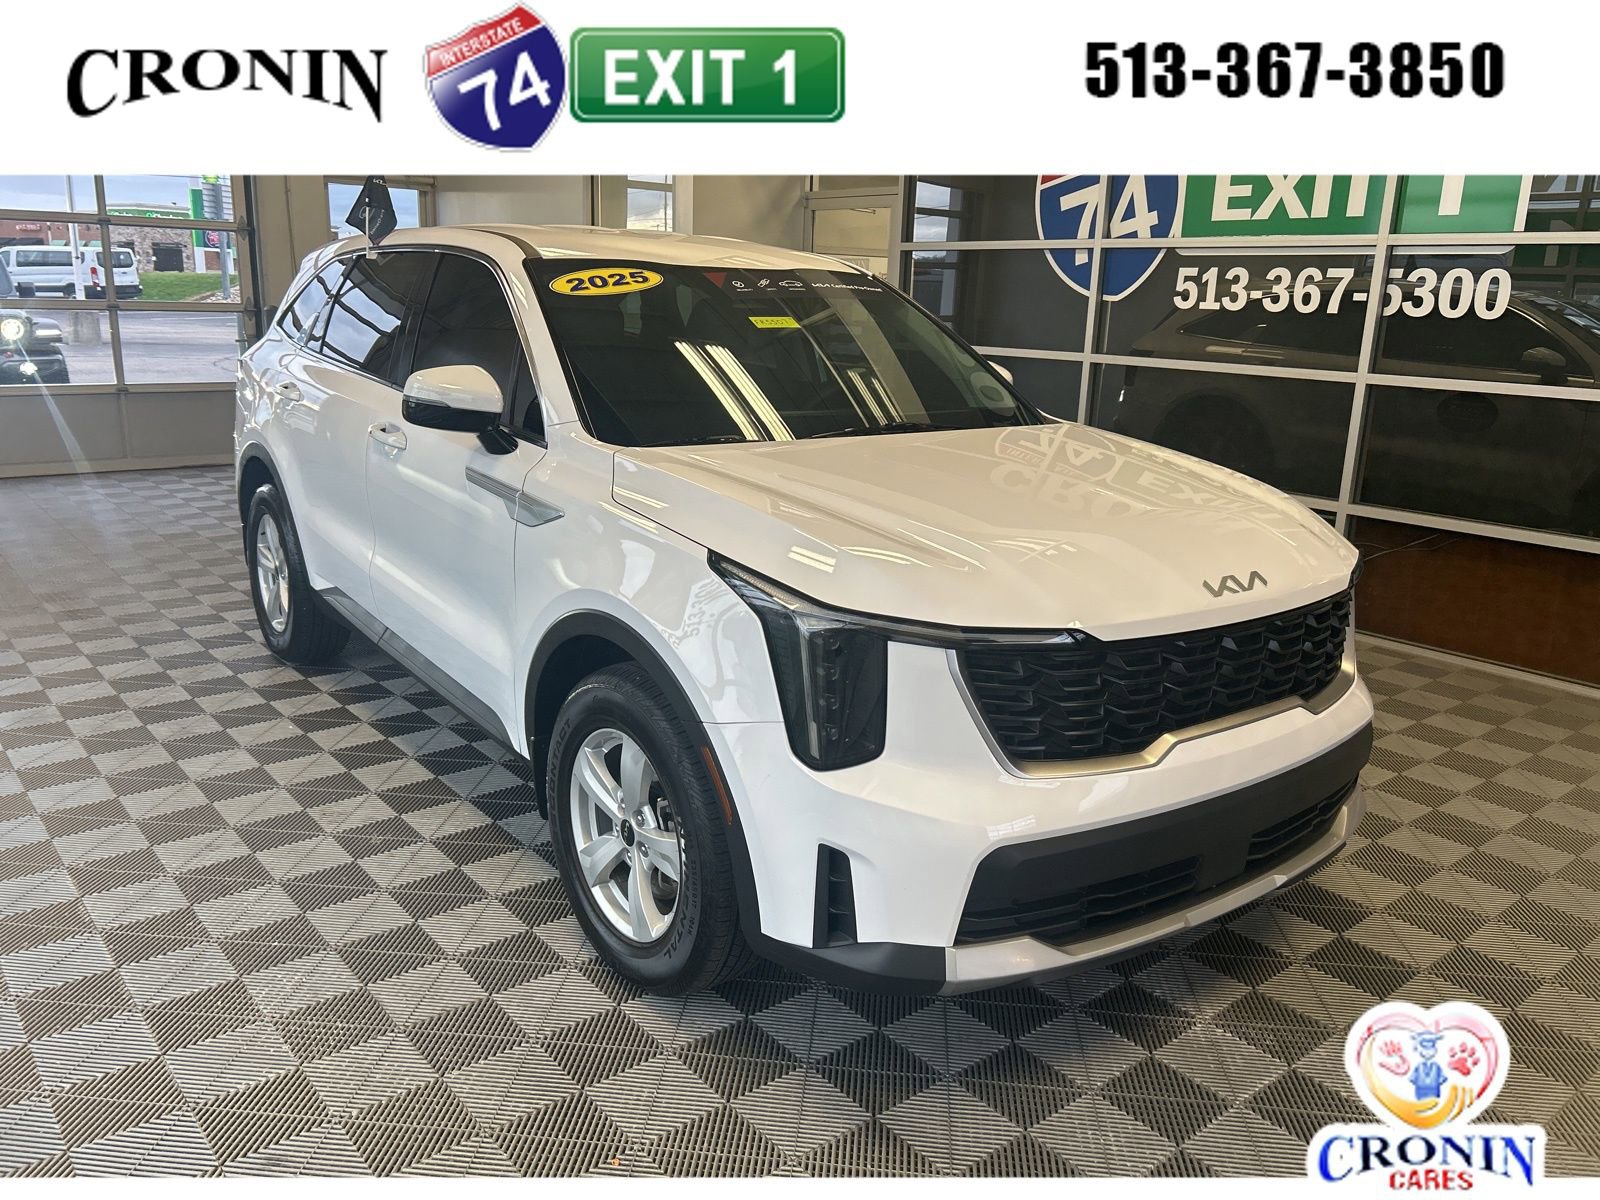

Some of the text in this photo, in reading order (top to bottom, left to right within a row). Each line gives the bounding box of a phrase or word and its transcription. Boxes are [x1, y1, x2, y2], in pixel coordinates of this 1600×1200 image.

[1060, 175, 1159, 266] 74
[566, 270, 649, 292] 2025
[1173, 267, 1511, 320] 513-367-5300
[1202, 570, 1268, 598] KIA
